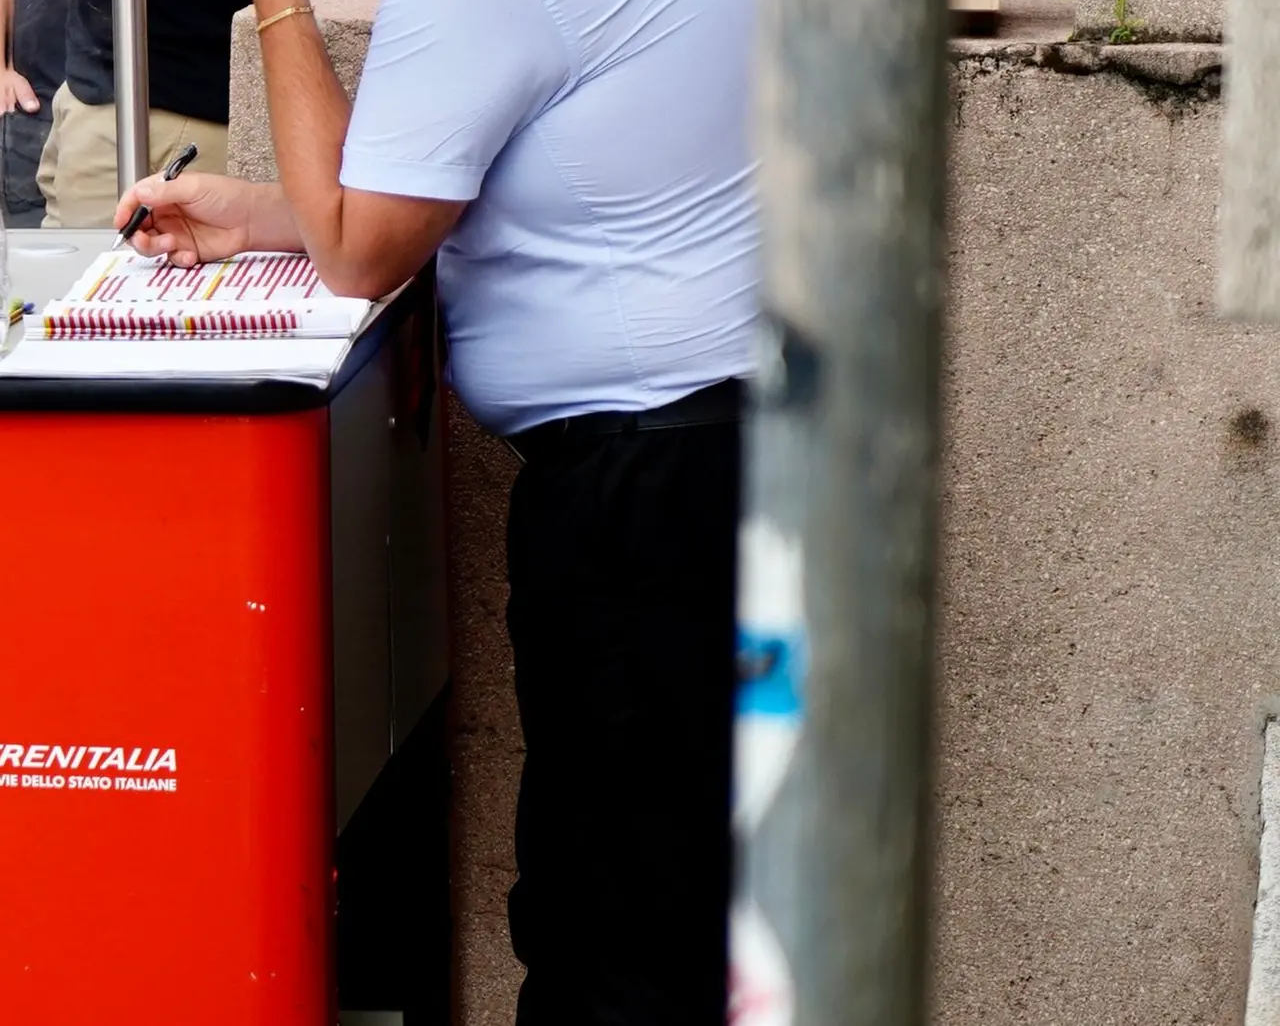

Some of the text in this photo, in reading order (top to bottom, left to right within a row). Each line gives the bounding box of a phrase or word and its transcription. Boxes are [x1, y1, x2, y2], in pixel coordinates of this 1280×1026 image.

[21, 773, 65, 789] DELLO
[68, 775, 112, 790] STATO
[115, 777, 177, 792] ITALIANE
